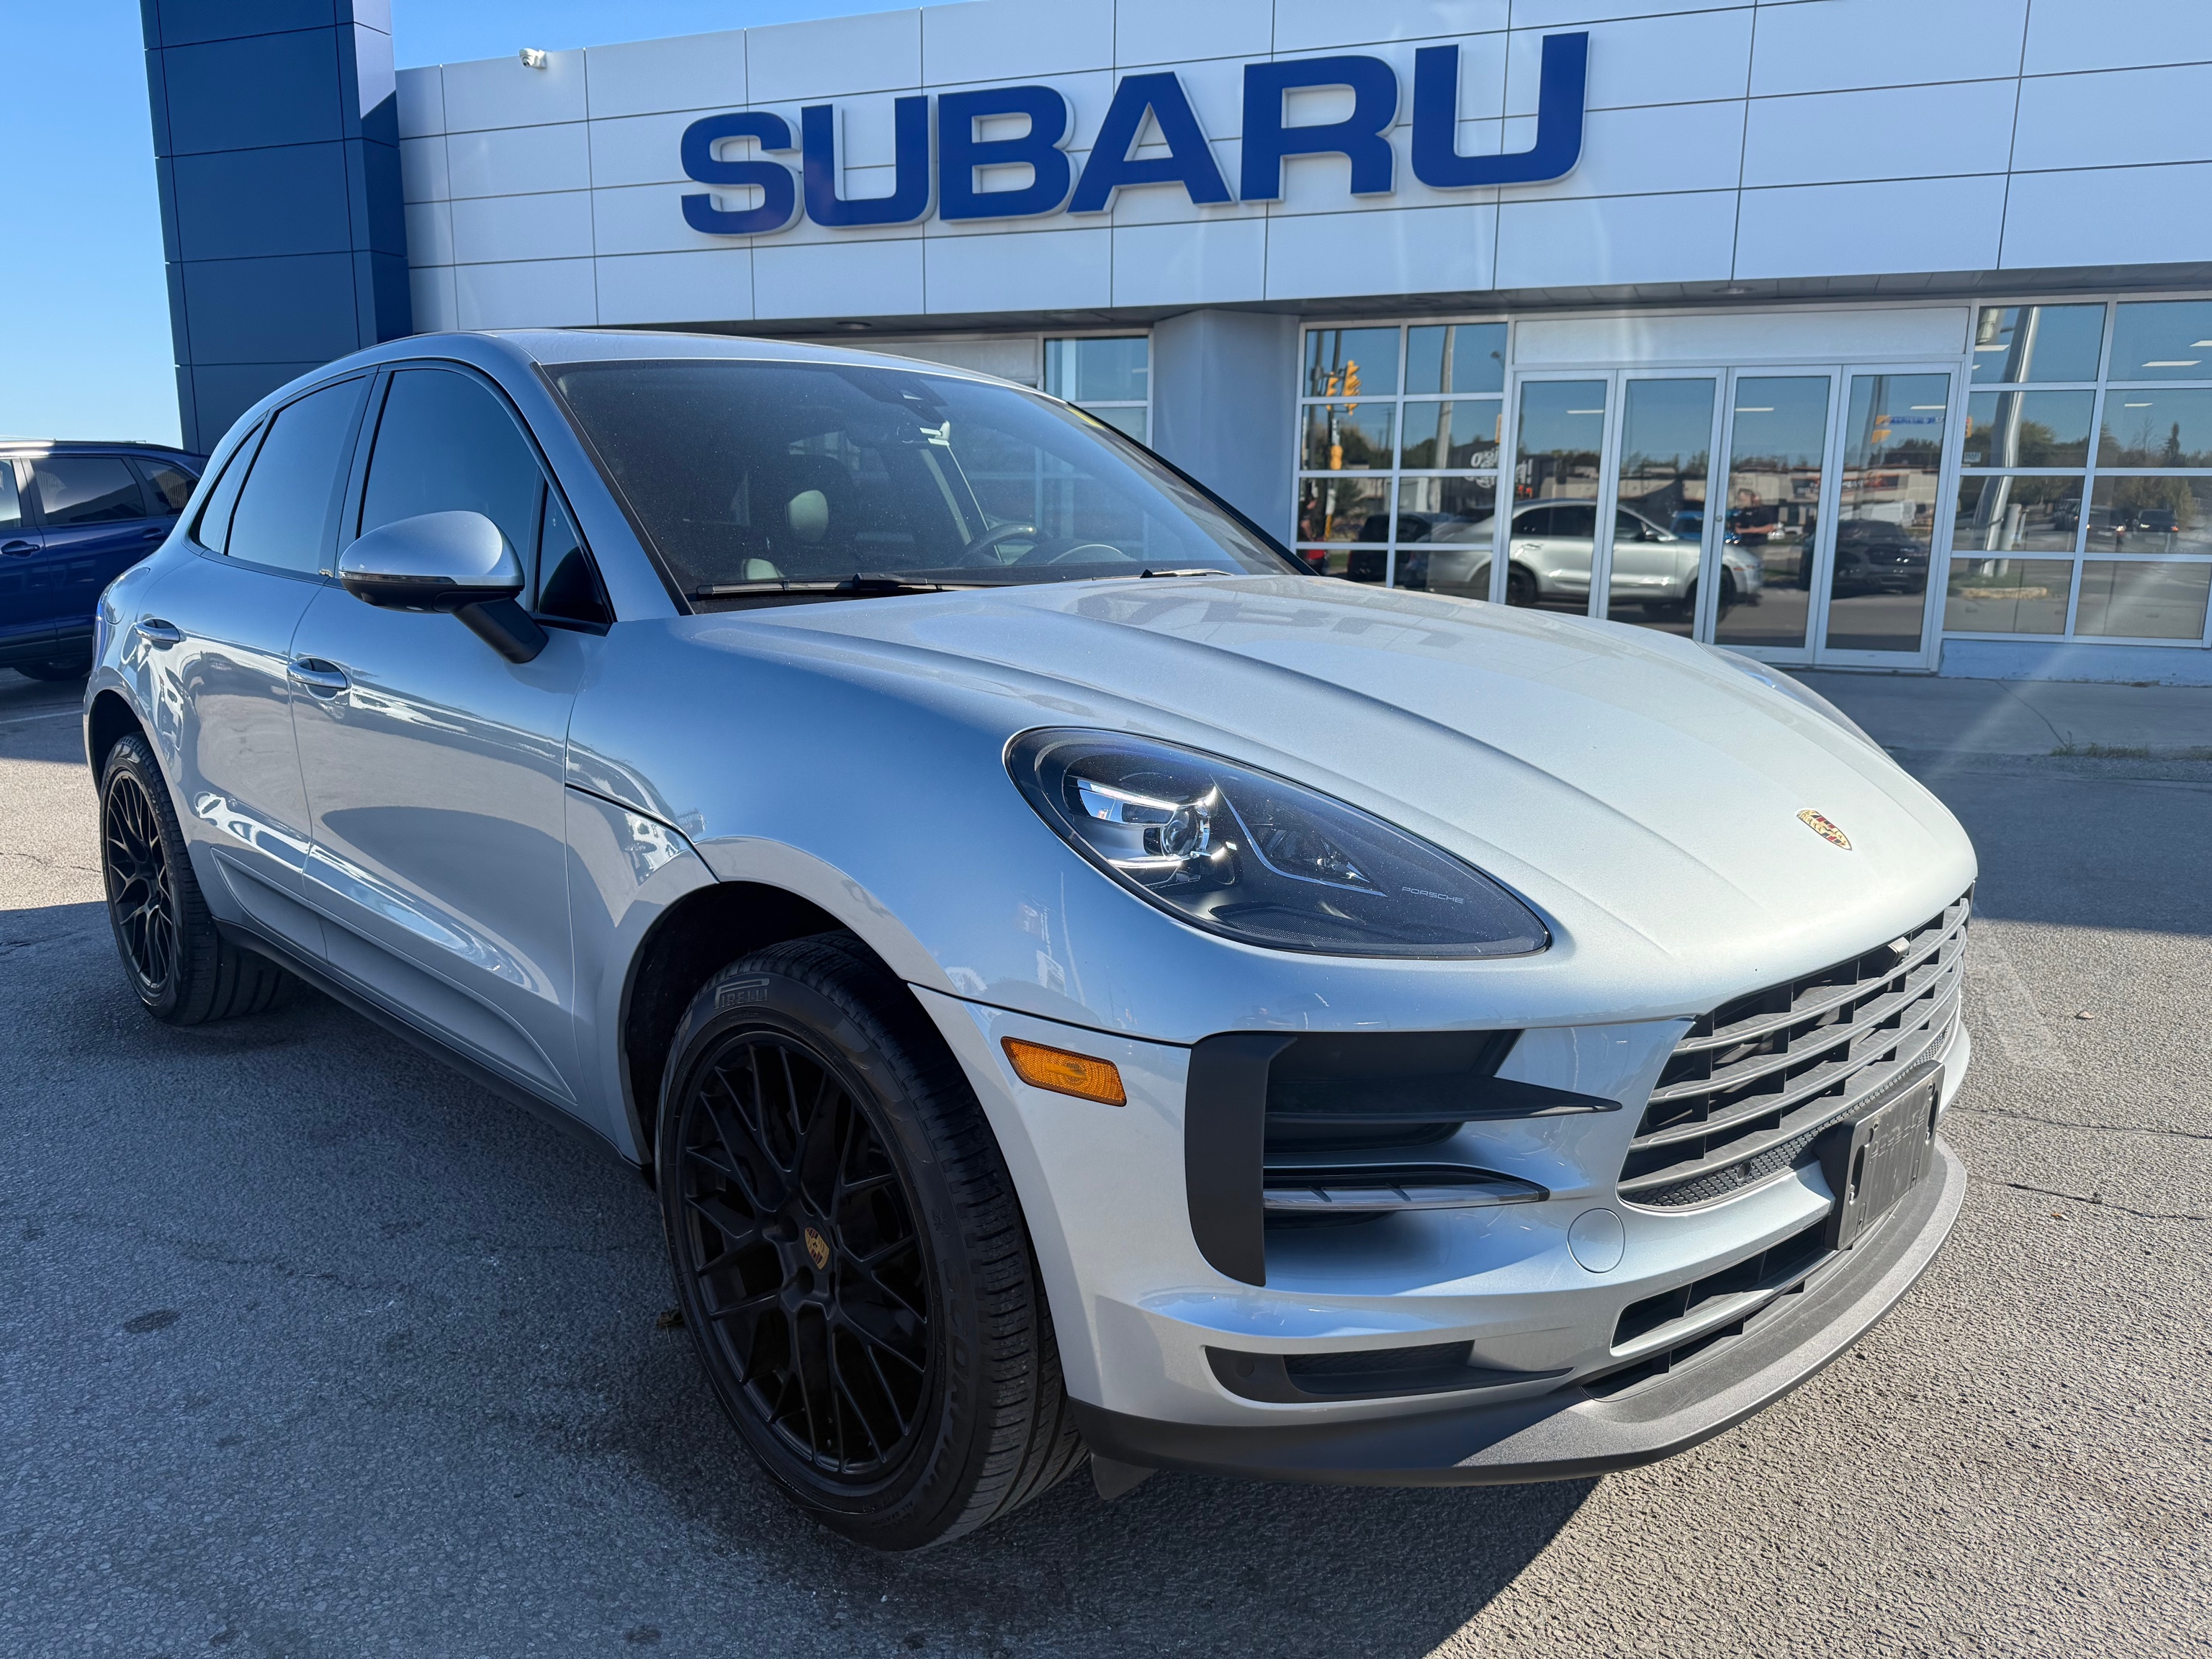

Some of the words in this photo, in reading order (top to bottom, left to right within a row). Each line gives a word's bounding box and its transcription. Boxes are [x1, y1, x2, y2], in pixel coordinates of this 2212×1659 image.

[680, 31, 1590, 236] SUBARU
[1401, 886, 1464, 904] PORSCHE
[715, 978, 770, 1010] PIRELLI
